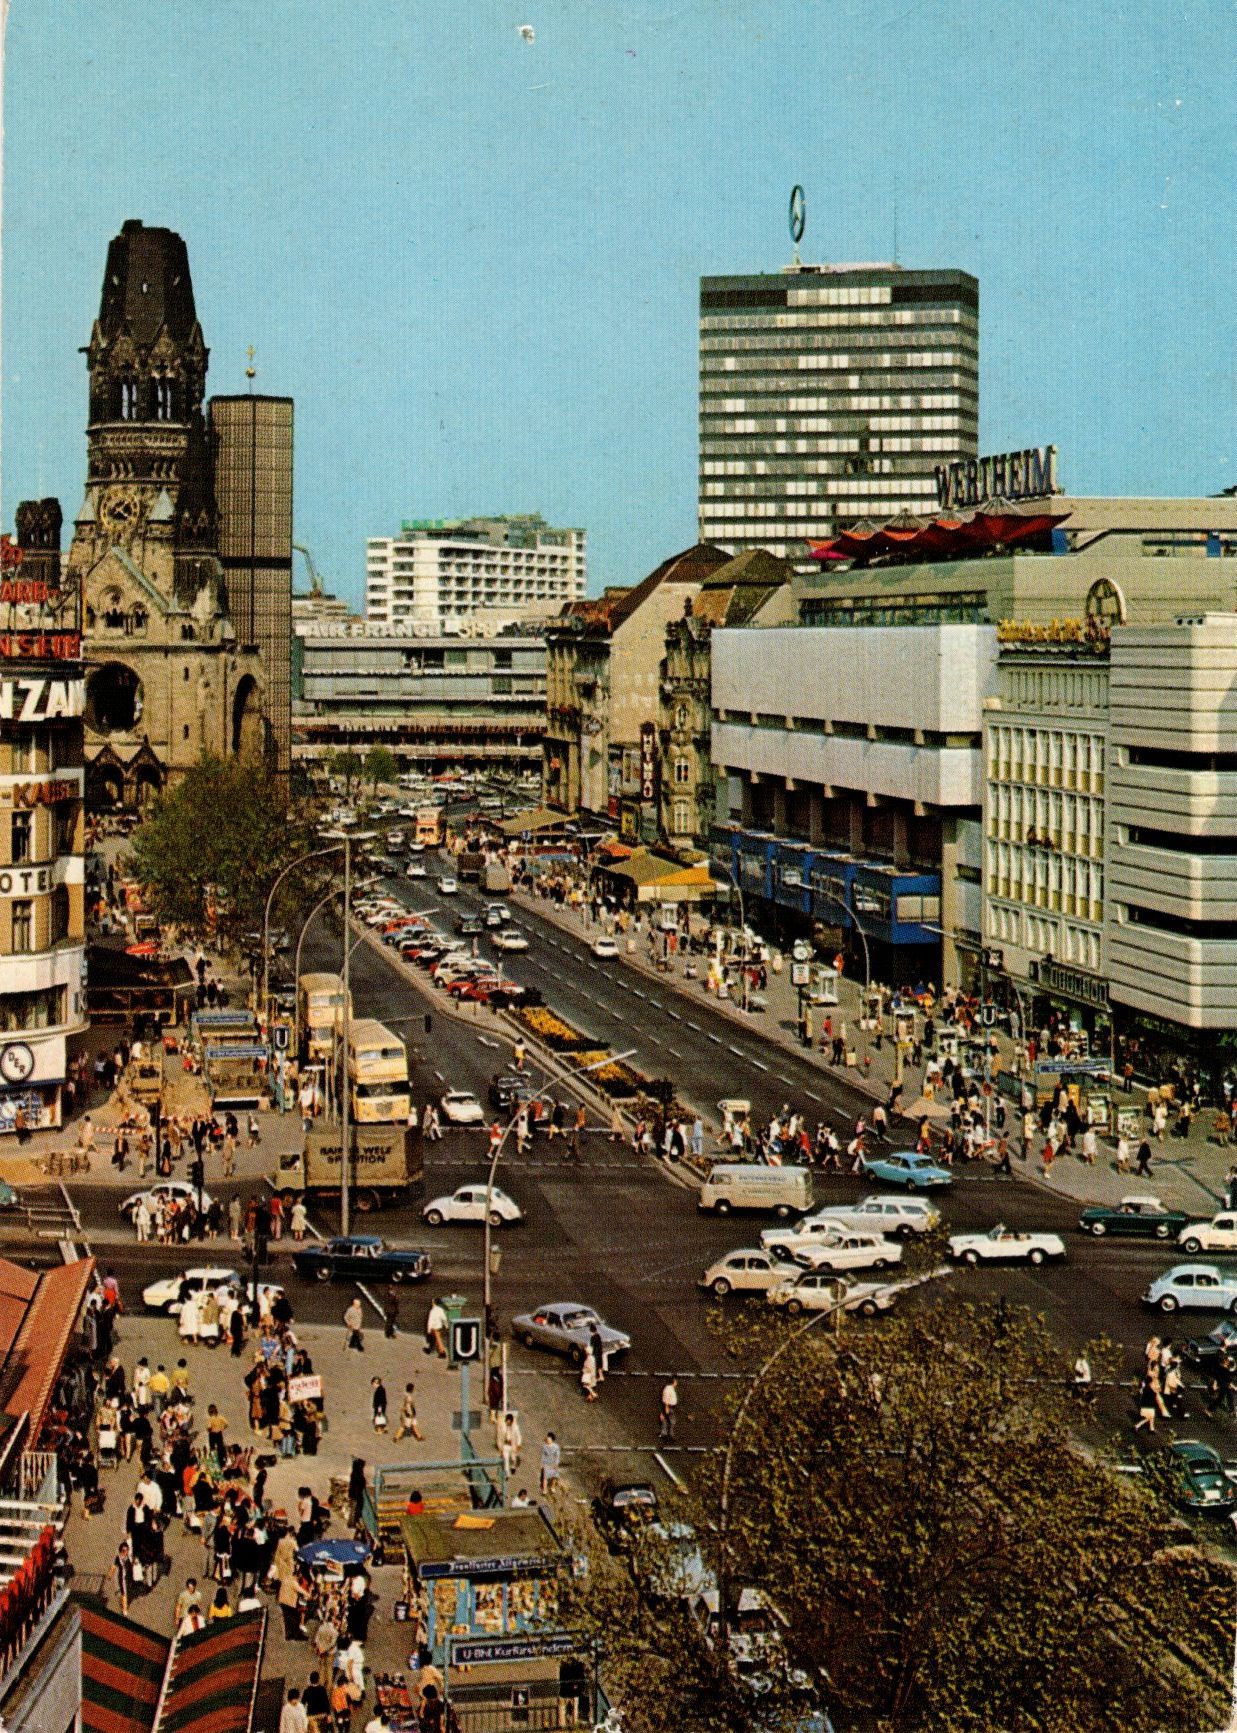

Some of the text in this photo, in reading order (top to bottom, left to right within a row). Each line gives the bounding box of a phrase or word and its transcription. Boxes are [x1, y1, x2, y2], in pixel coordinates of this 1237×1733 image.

[935, 446, 1057, 508] WERTHEIM
[350, 621, 441, 638] FRANCE
[982, 1007, 996, 1025] U
[276, 1029, 288, 1048] U
[455, 1326, 477, 1357] U
